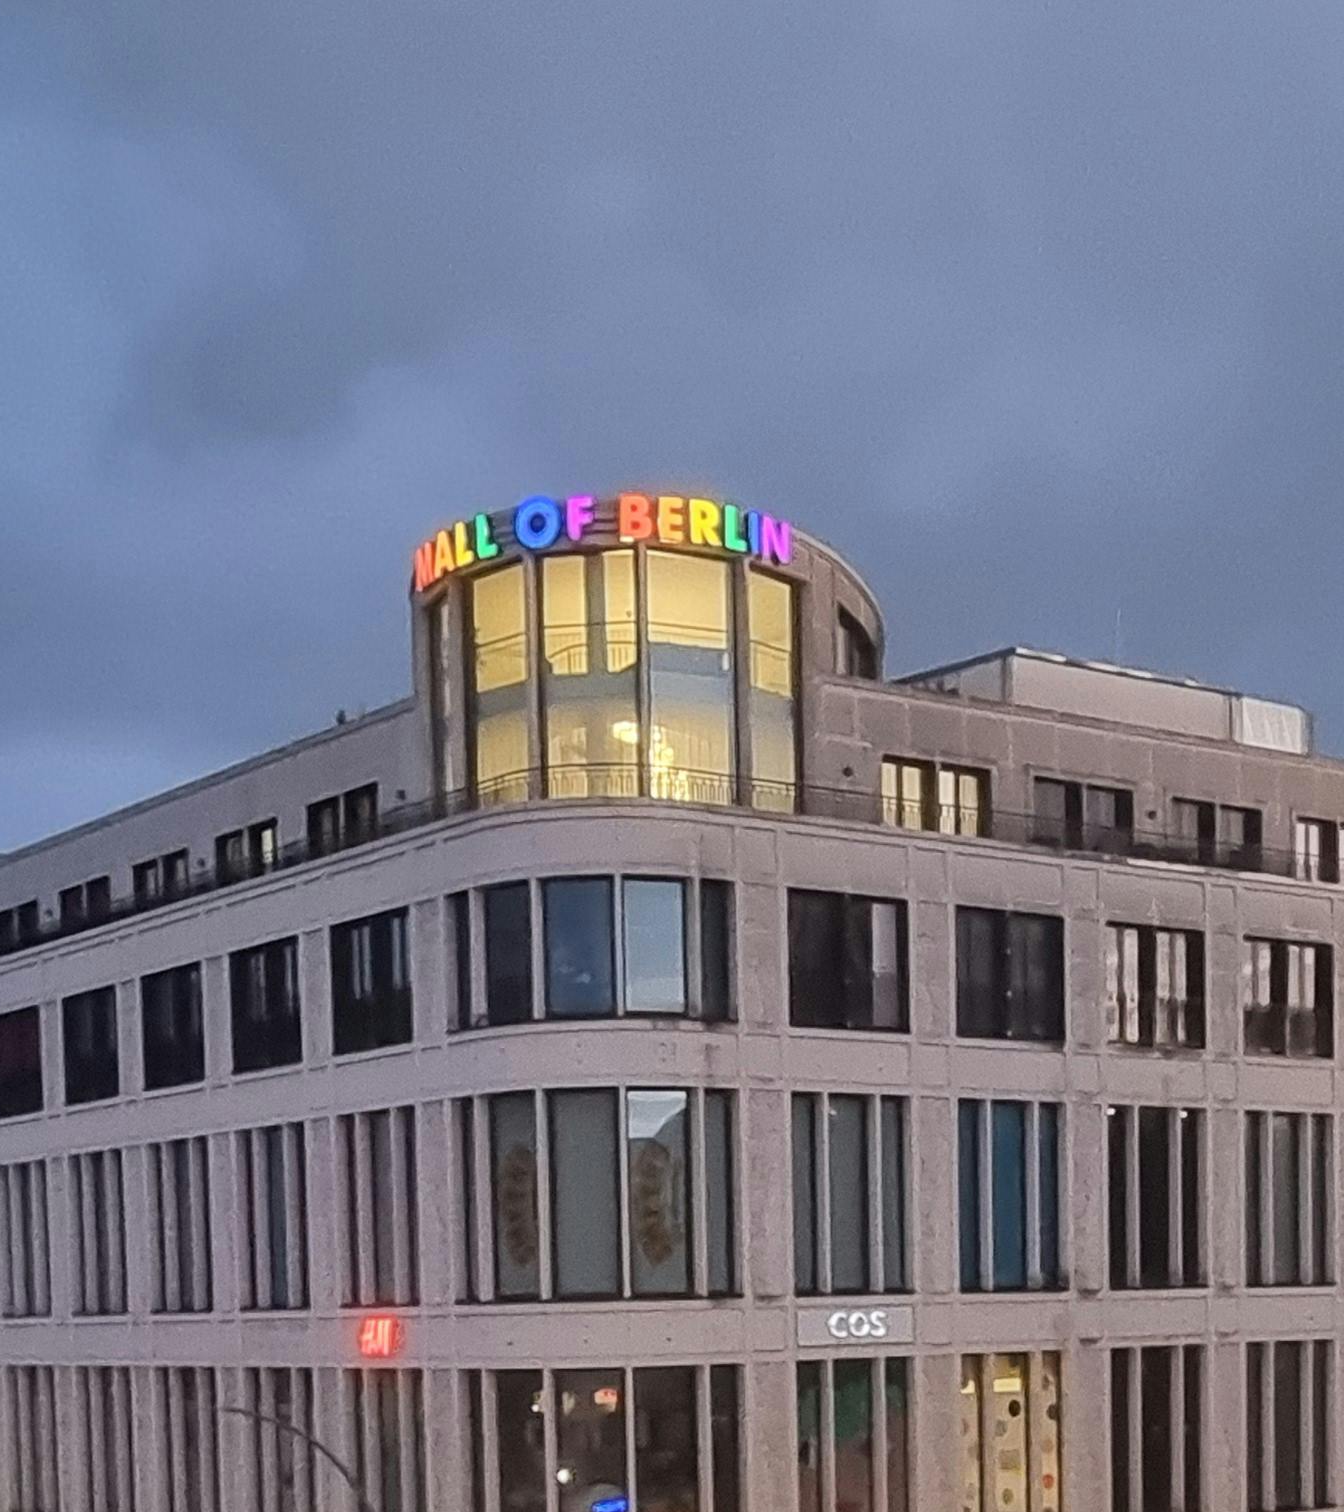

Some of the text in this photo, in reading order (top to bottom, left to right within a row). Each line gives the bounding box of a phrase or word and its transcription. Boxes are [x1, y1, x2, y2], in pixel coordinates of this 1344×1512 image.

[415, 494, 792, 592] MALL OF BERLIN
[827, 1310, 887, 1338] COS
